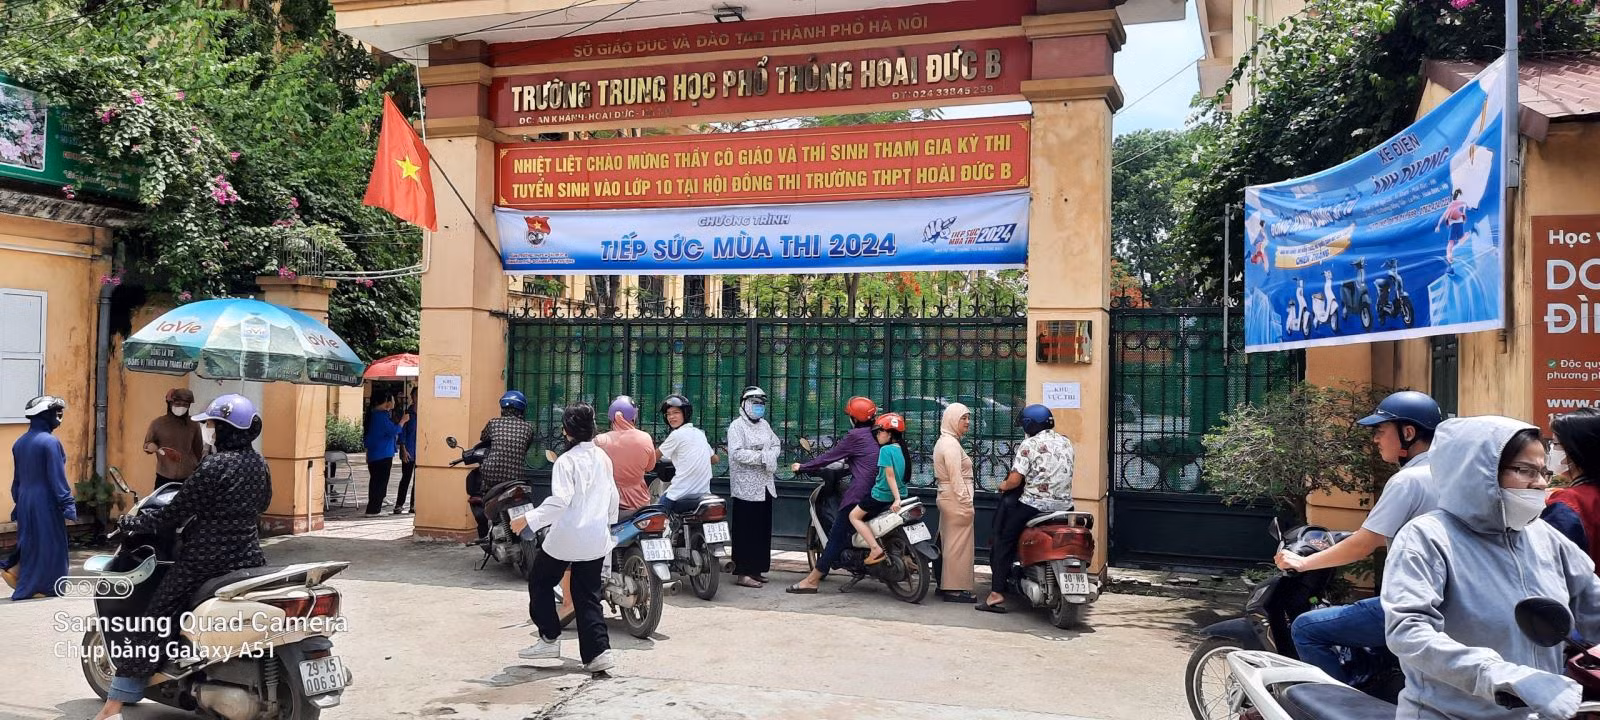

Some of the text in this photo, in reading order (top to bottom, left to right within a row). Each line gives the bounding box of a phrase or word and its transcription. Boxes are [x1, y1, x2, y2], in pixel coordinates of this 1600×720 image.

[597, 75, 667, 107] TRUNG
[673, 72, 716, 107] HỌC
[722, 55, 769, 98] PHỔ
[985, 48, 1001, 80] B
[513, 155, 552, 177] NHIỆT
[555, 154, 583, 176] LIỆT
[586, 153, 623, 172] CHÀO
[627, 150, 669, 170] MỪNG
[714, 147, 734, 167] CÔ
[738, 145, 773, 165] GIÁO
[778, 143, 797, 164] VÀ
[801, 142, 826, 163] THÍ
[830, 142, 869, 161] SINH
[873, 139, 919, 159] THAM
[924, 137, 952, 156] GIA
[984, 133, 1011, 152] THI
[1376, 147, 1395, 164] XE
[512, 160, 1012, 199] TUYỂN SINH VÀO LỚP 10 TẠI HỘI ĐỒNG THI TRƯỜNG THPT HOÀI ĐỨC B
[697, 211, 792, 228] CHƯƠNG TRÌNH
[978, 224, 1013, 244] 2024
[1548, 229, 1592, 248] Học
[600, 229, 898, 263] TIẾP SỨC MÙA THI 2024
[1560, 359, 1582, 370] Độc
[1546, 371, 1589, 381] phương
[306, 658, 337, 677] 29-X5
[306, 673, 343, 692] 006.91
